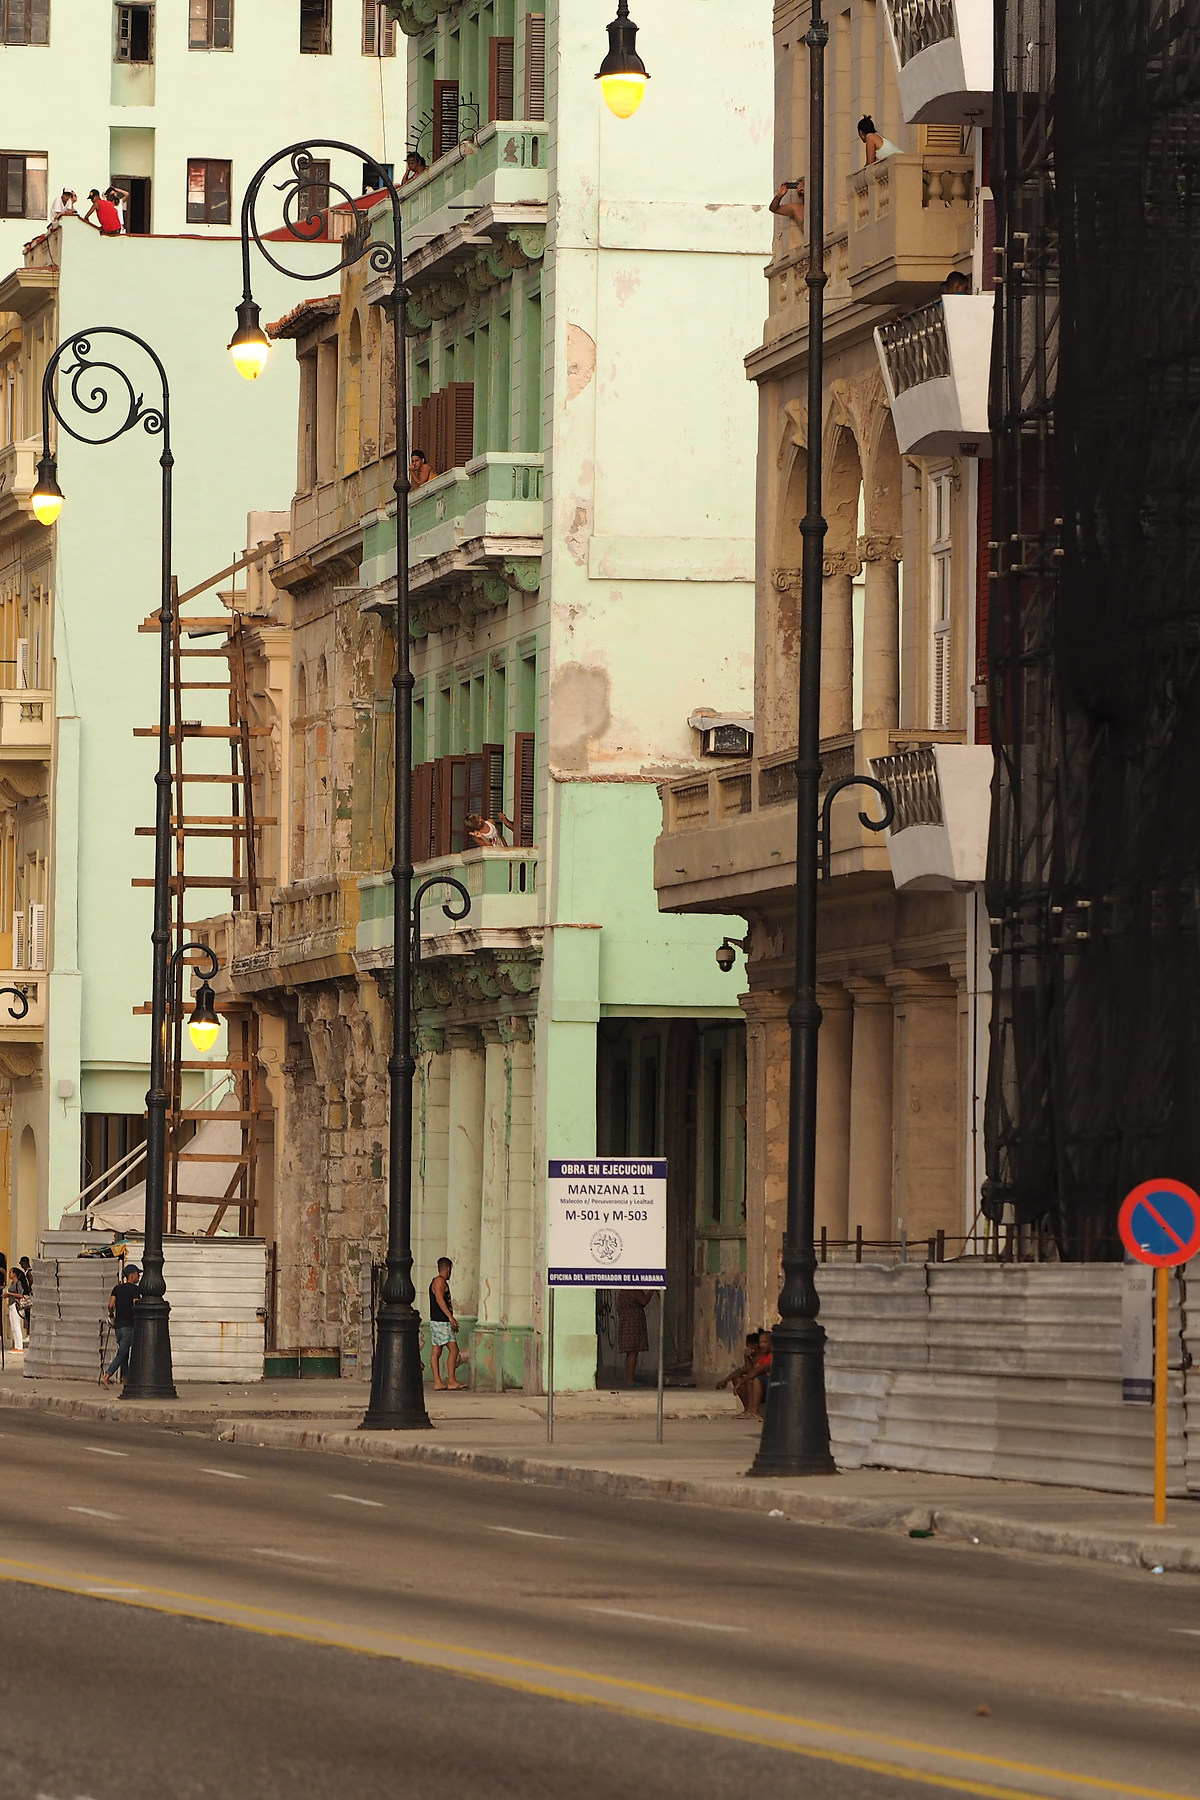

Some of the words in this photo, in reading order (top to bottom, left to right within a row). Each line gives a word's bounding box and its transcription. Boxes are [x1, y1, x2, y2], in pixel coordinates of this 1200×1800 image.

[561, 1164, 586, 1175] OBRA
[588, 1164, 600, 1175] EN
[602, 1164, 654, 1175] EJECUCION
[568, 1184, 629, 1195] MANZANA
[632, 1184, 645, 1195] 11
[591, 1198, 628, 1206] Perseverancia
[565, 1210, 600, 1221] M-501
[603, 1212, 610, 1223] y
[612, 1210, 648, 1221] M-503
[549, 1273, 572, 1282] OFICINA
[573, 1273, 584, 1282] DEL
[585, 1273, 622, 1282] HISTORIADOR
[623, 1273, 631, 1282] DE
[632, 1273, 640, 1282] LA
[641, 1273, 664, 1282] HABANA
